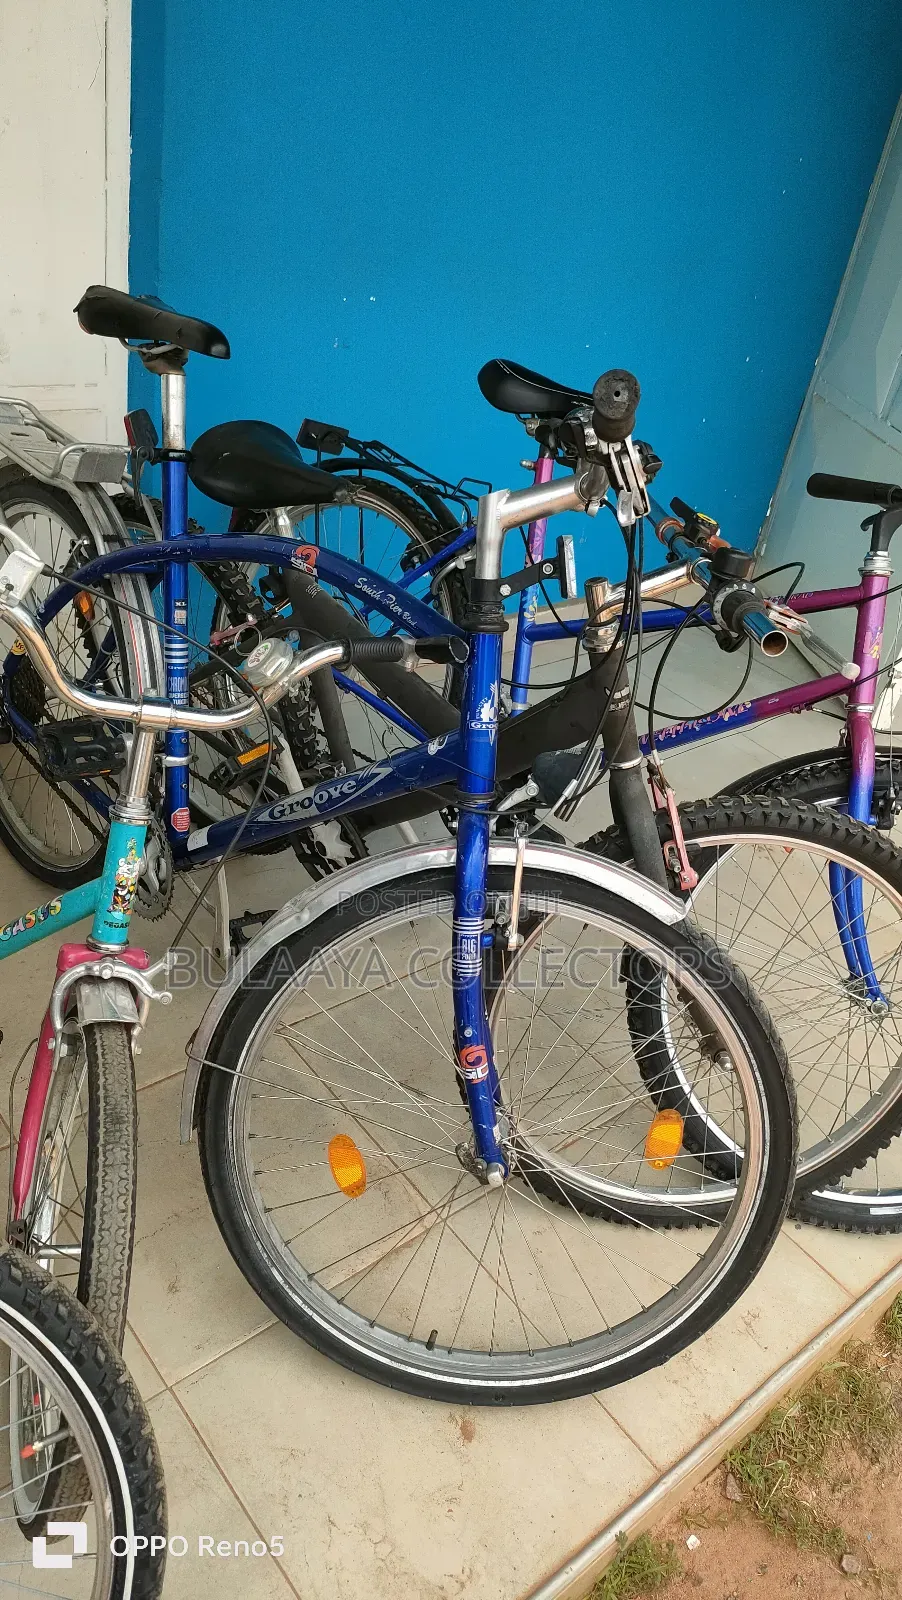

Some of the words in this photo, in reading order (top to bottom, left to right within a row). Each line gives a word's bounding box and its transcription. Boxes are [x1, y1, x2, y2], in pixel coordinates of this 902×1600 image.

[354, 577, 385, 600] South
[382, 593, 403, 616] Pier
[268, 779, 358, 820] Groove
[461, 938, 477, 953] BIG
